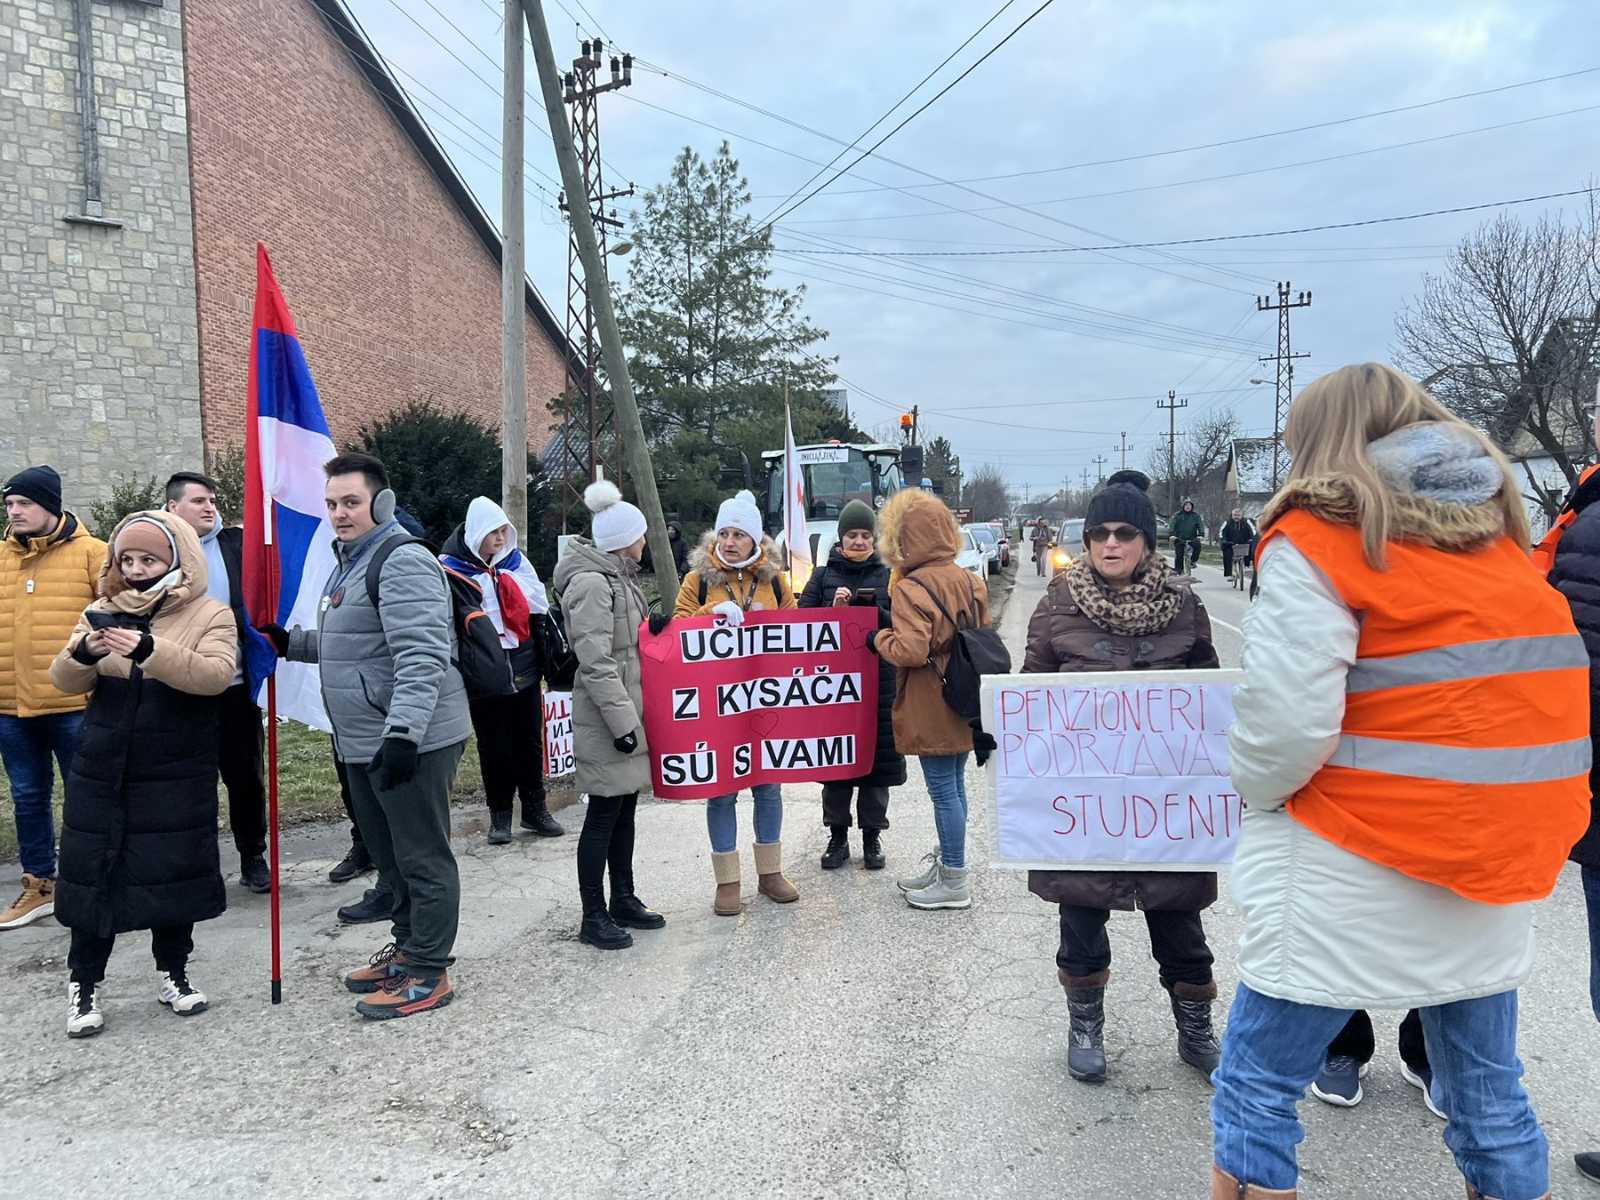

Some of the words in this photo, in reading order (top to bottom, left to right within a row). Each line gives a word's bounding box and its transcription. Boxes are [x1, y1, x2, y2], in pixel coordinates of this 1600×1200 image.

[681, 620, 840, 661] UČITELIA
[674, 688, 699, 720] Z
[717, 666, 861, 716] KYSÁČA
[1001, 687, 1206, 733] PENZIONERI
[661, 742, 714, 784] SÚ
[734, 745, 750, 776] S
[764, 735, 854, 769] VAMI
